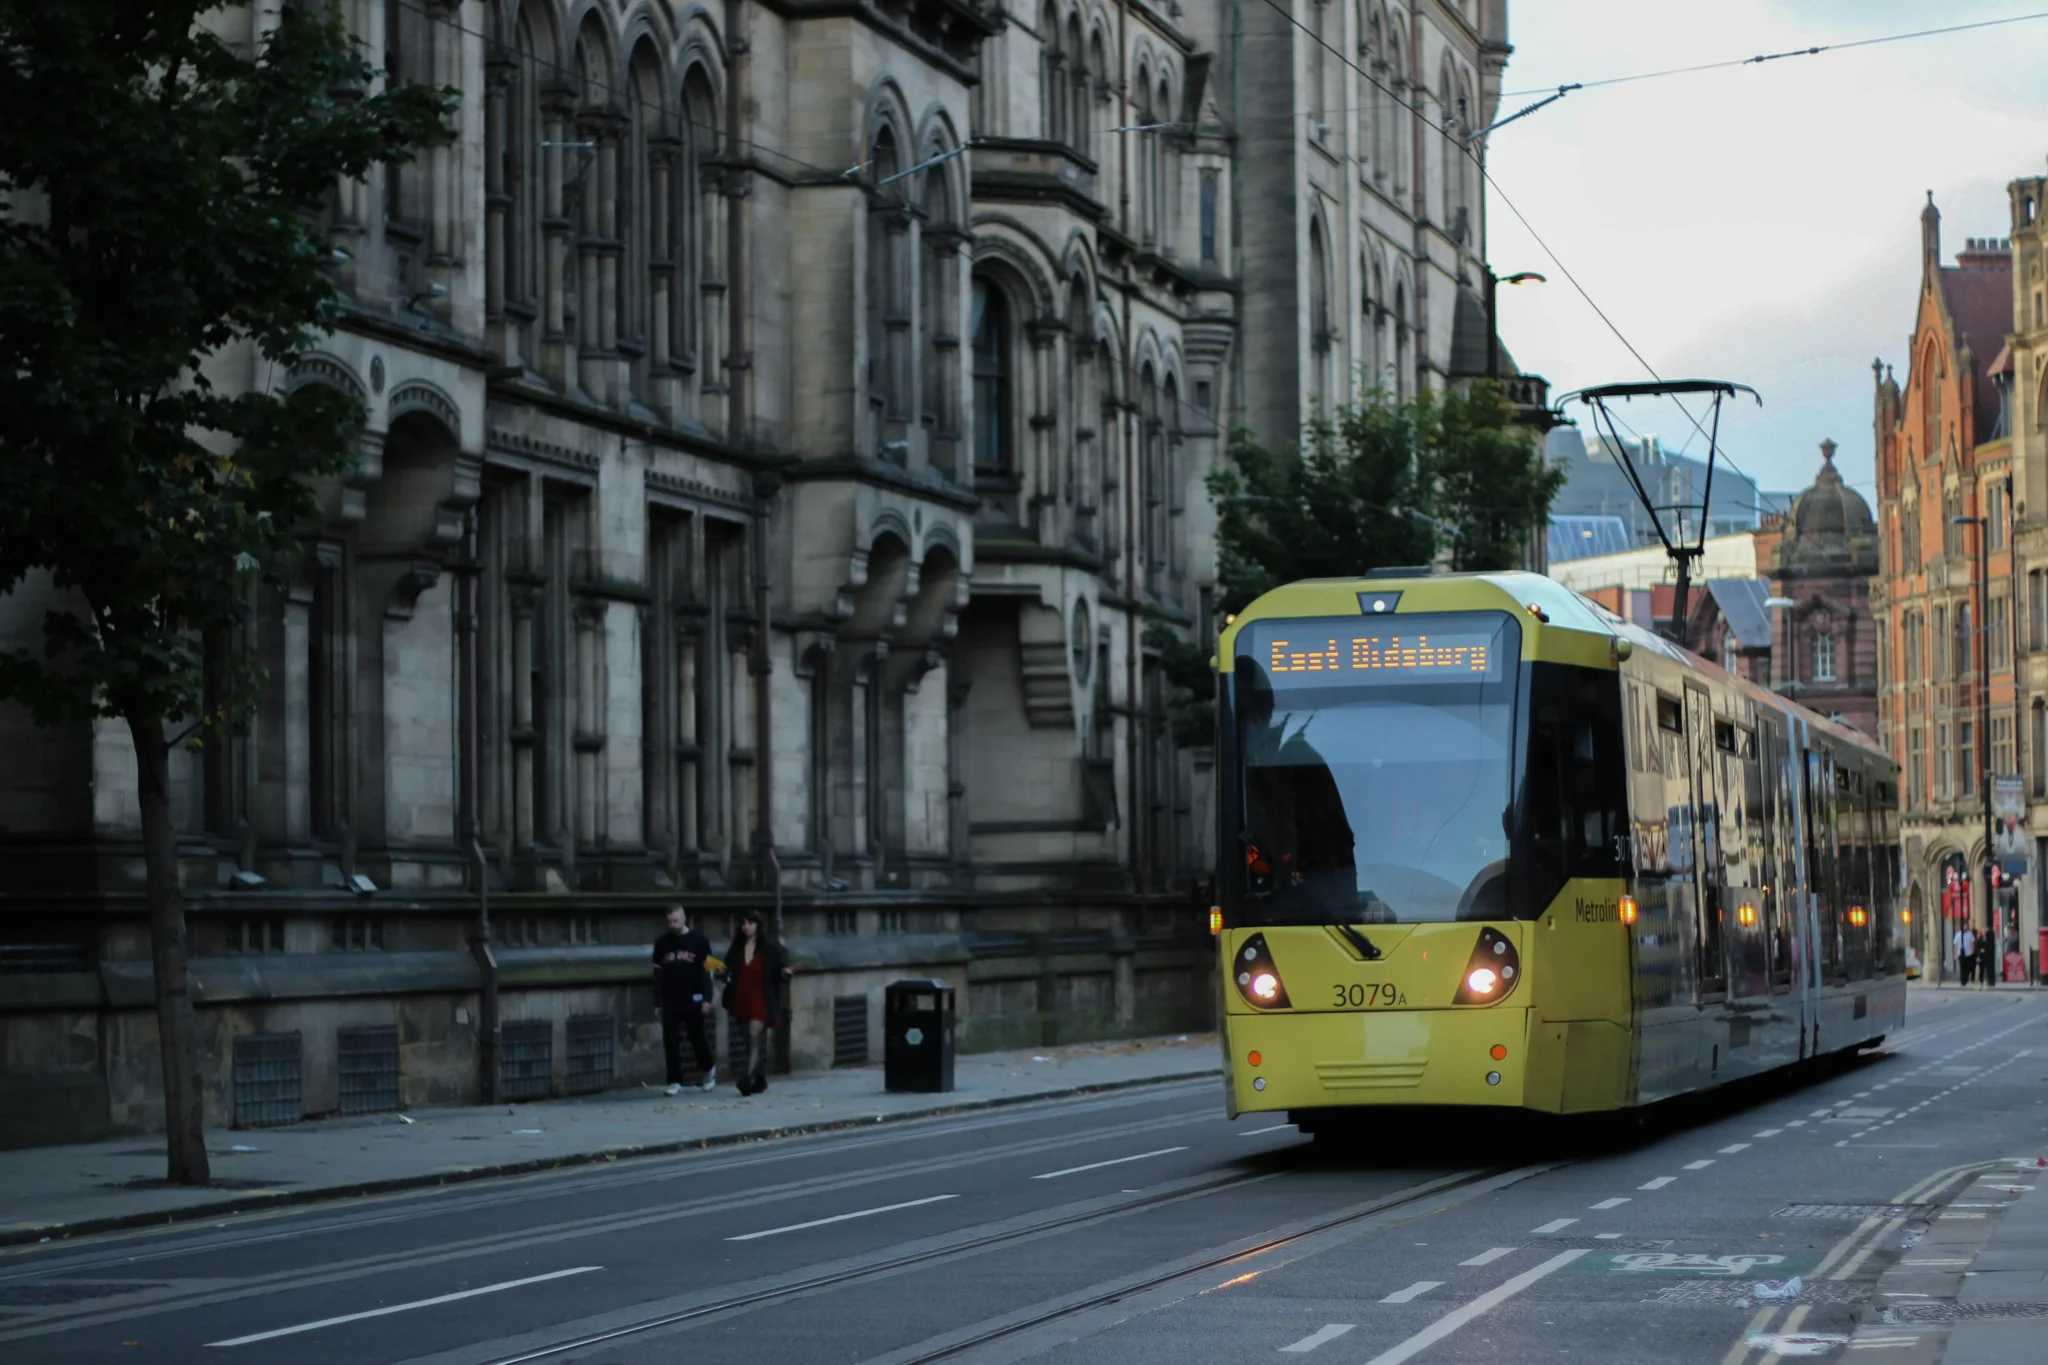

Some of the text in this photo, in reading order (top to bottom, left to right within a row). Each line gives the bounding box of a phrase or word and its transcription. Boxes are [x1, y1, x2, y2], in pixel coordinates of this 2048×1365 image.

[1271, 636, 1486, 672] East Didsbury
[1575, 897, 1619, 923] Metrolin
